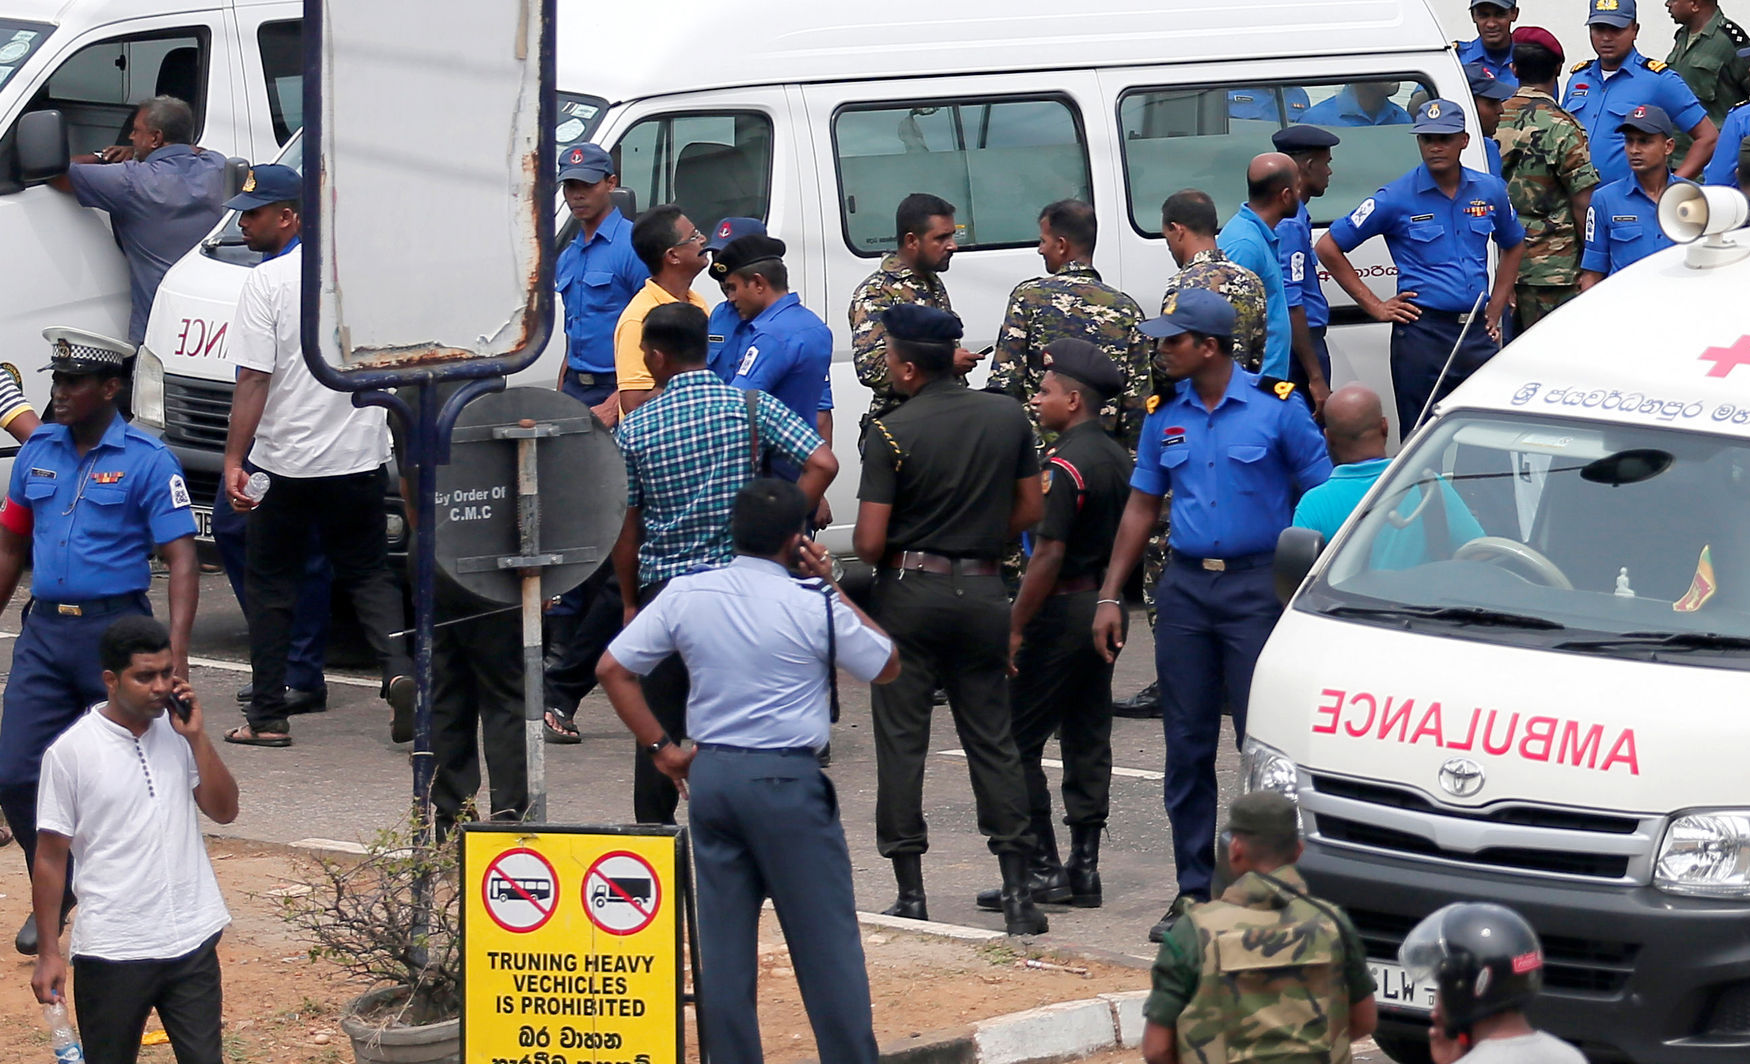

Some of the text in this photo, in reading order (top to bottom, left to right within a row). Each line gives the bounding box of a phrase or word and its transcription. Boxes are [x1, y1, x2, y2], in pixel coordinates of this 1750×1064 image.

[454, 489, 489, 502] Order
[492, 486, 506, 499] Of
[450, 506, 492, 521] C.M.C
[487, 952, 654, 973] TRUNING HEAVY
[513, 974, 627, 994] VECHICLES
[496, 996, 645, 1016] IS PROHIBITED
[519, 1025, 550, 1048] බර
